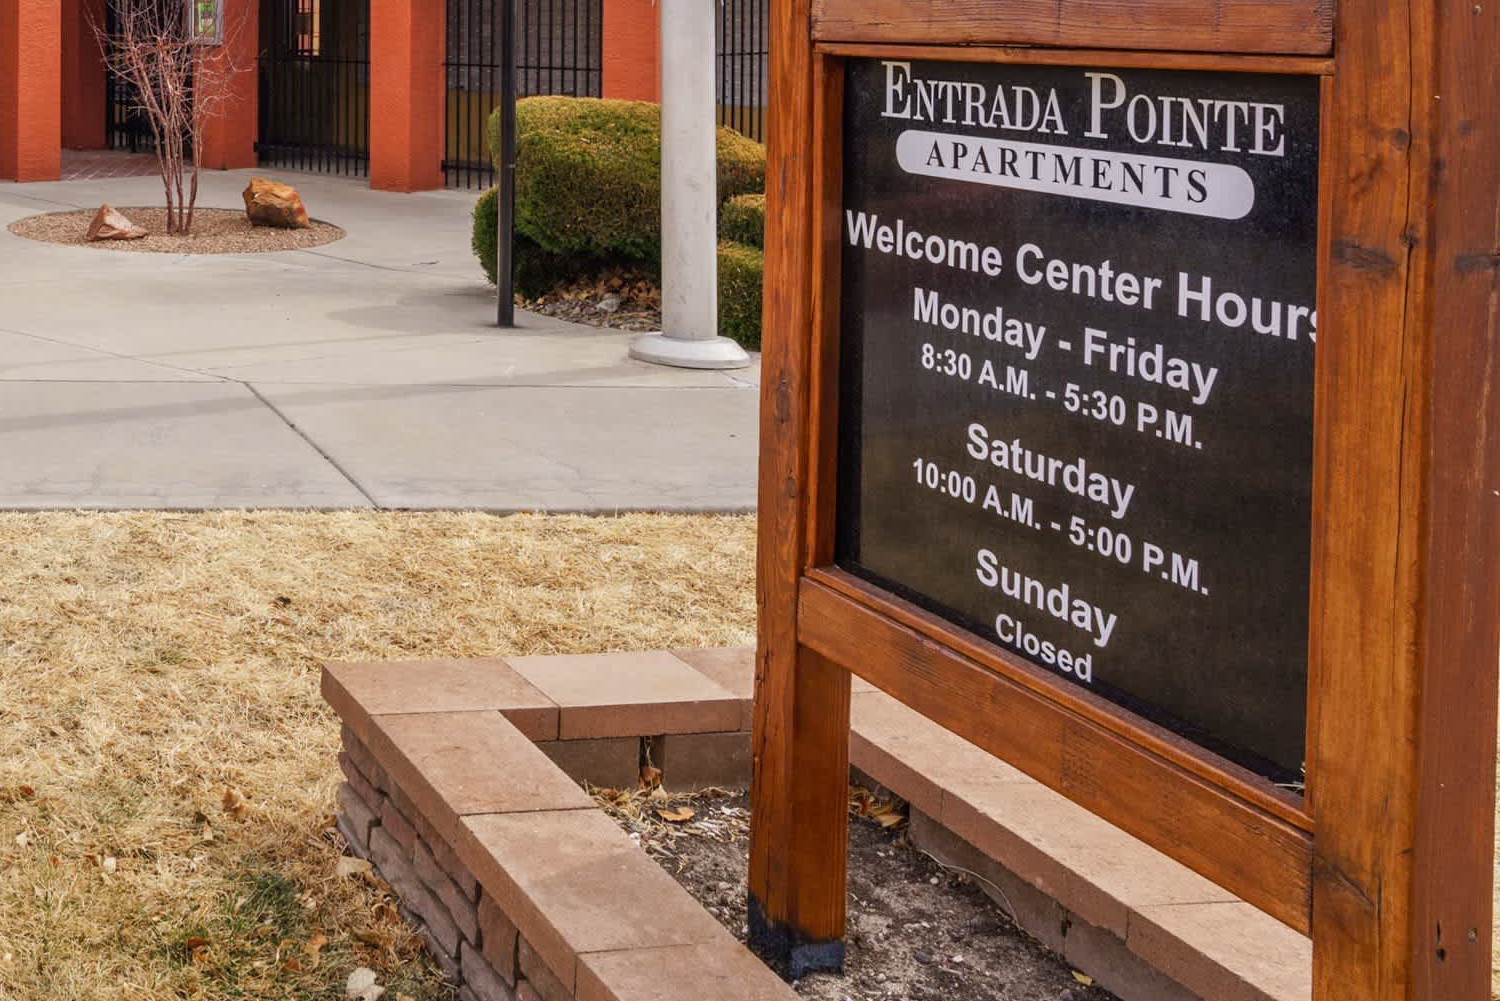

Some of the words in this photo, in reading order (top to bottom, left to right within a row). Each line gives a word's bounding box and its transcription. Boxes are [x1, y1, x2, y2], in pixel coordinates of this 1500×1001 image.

[880, 61, 1069, 136] ENTRADA
[1083, 72, 1285, 157] POINTE
[925, 140, 1209, 205] APARTMENTS
[846, 209, 1003, 277] Welcome
[1015, 242, 1163, 310] Center
[913, 287, 1047, 361] Monday
[1058, 339, 1072, 351] -
[1083, 327, 1219, 406] Friday
[921, 342, 972, 381] 8:30
[977, 359, 1038, 400] A.M.
[1045, 390, 1056, 400] -
[1063, 382, 1126, 426] 5:30
[1137, 401, 1203, 450] P.M.
[966, 422, 1135, 520] Saturday
[912, 457, 977, 504] 10:00
[981, 484, 1042, 531] A.M.
[1050, 521, 1061, 531] -
[1068, 515, 1132, 564] 5:00
[1142, 541, 1209, 596] P.M.
[975, 548, 1118, 648] Sunday
[995, 613, 1093, 683] Closed
